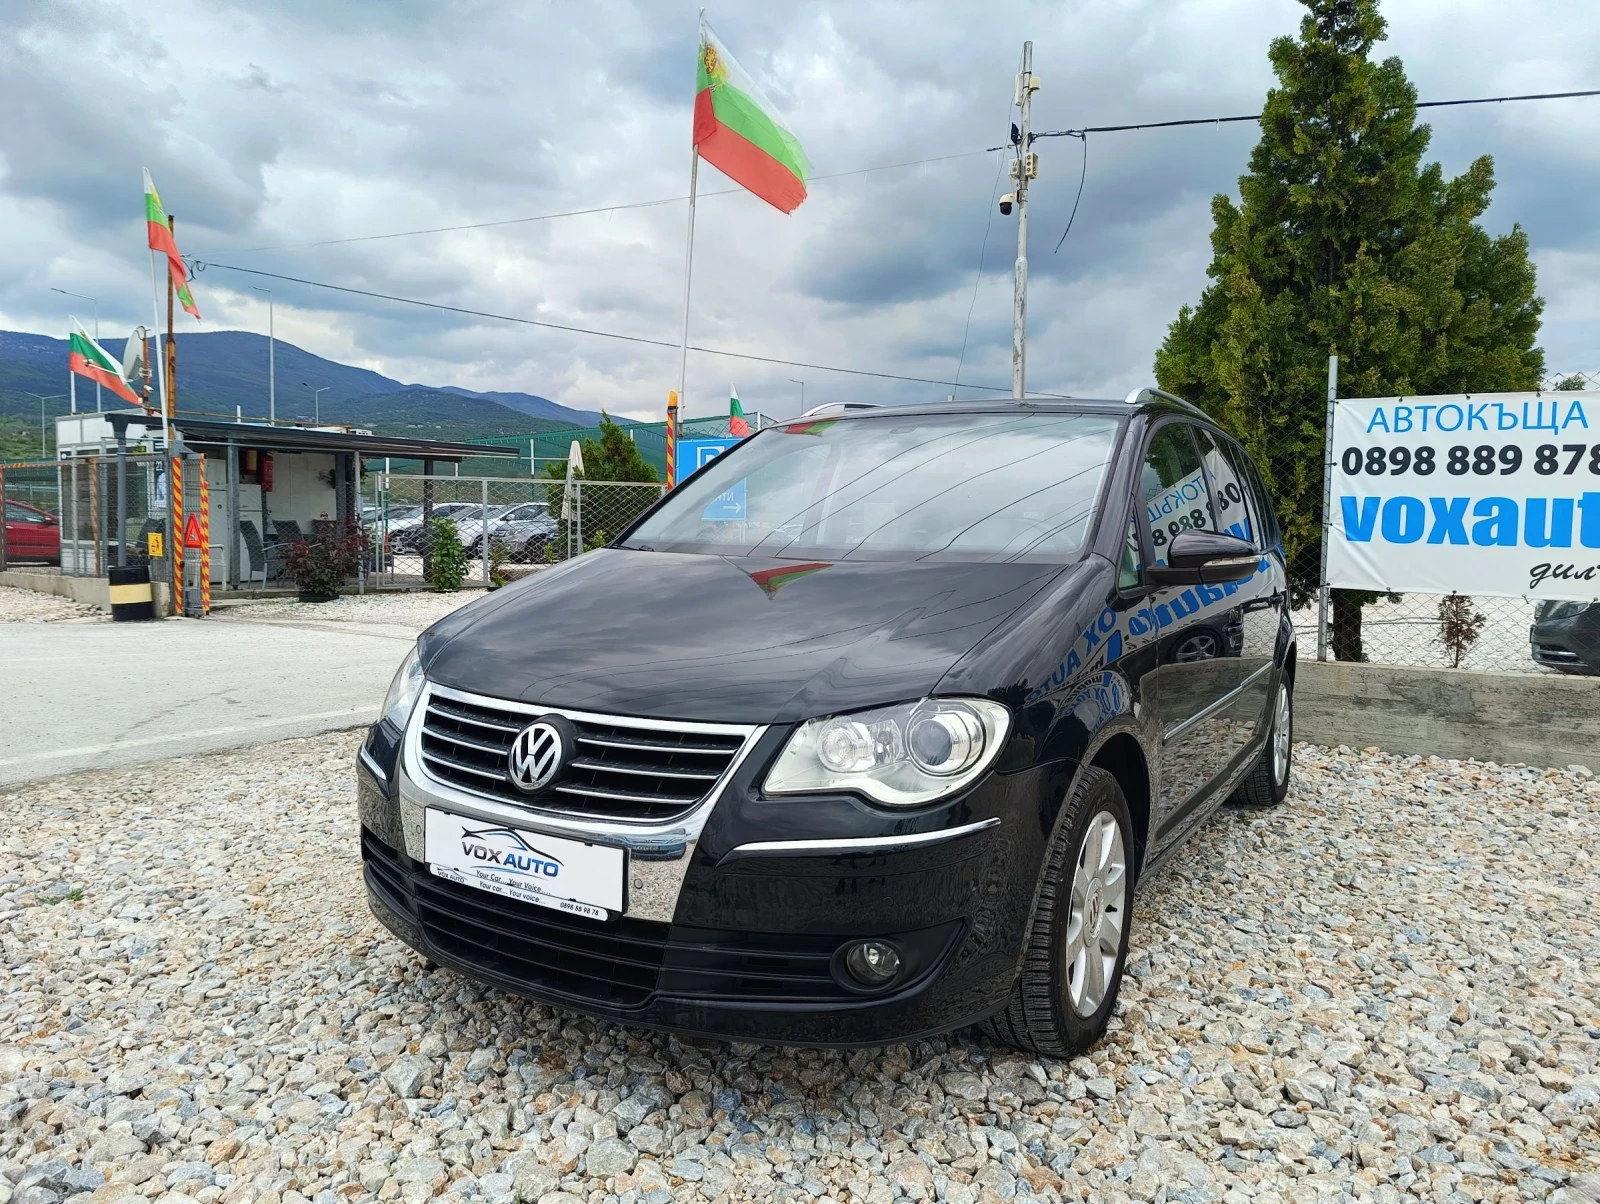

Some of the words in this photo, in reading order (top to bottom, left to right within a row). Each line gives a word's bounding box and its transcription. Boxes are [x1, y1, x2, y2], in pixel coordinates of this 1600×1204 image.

[1366, 400, 1589, 436] АВТОКЪЩА
[1341, 445, 1436, 476] 0898
[1446, 444, 1523, 476] 889
[1529, 562, 1600, 589] дил
[461, 841, 502, 864] VOX
[503, 853, 559, 878] AUTO
[437, 870, 449, 879] VOX
[450, 874, 465, 883] AUTO
[476, 869, 489, 879] Your
[508, 877, 522, 888] Your
[479, 880, 492, 890] Your
[509, 888, 522, 898] Your
[559, 901, 574, 911] 0898
[574, 905, 583, 913] 88
[583, 907, 591, 915] 98
[591, 908, 599, 916] 78
